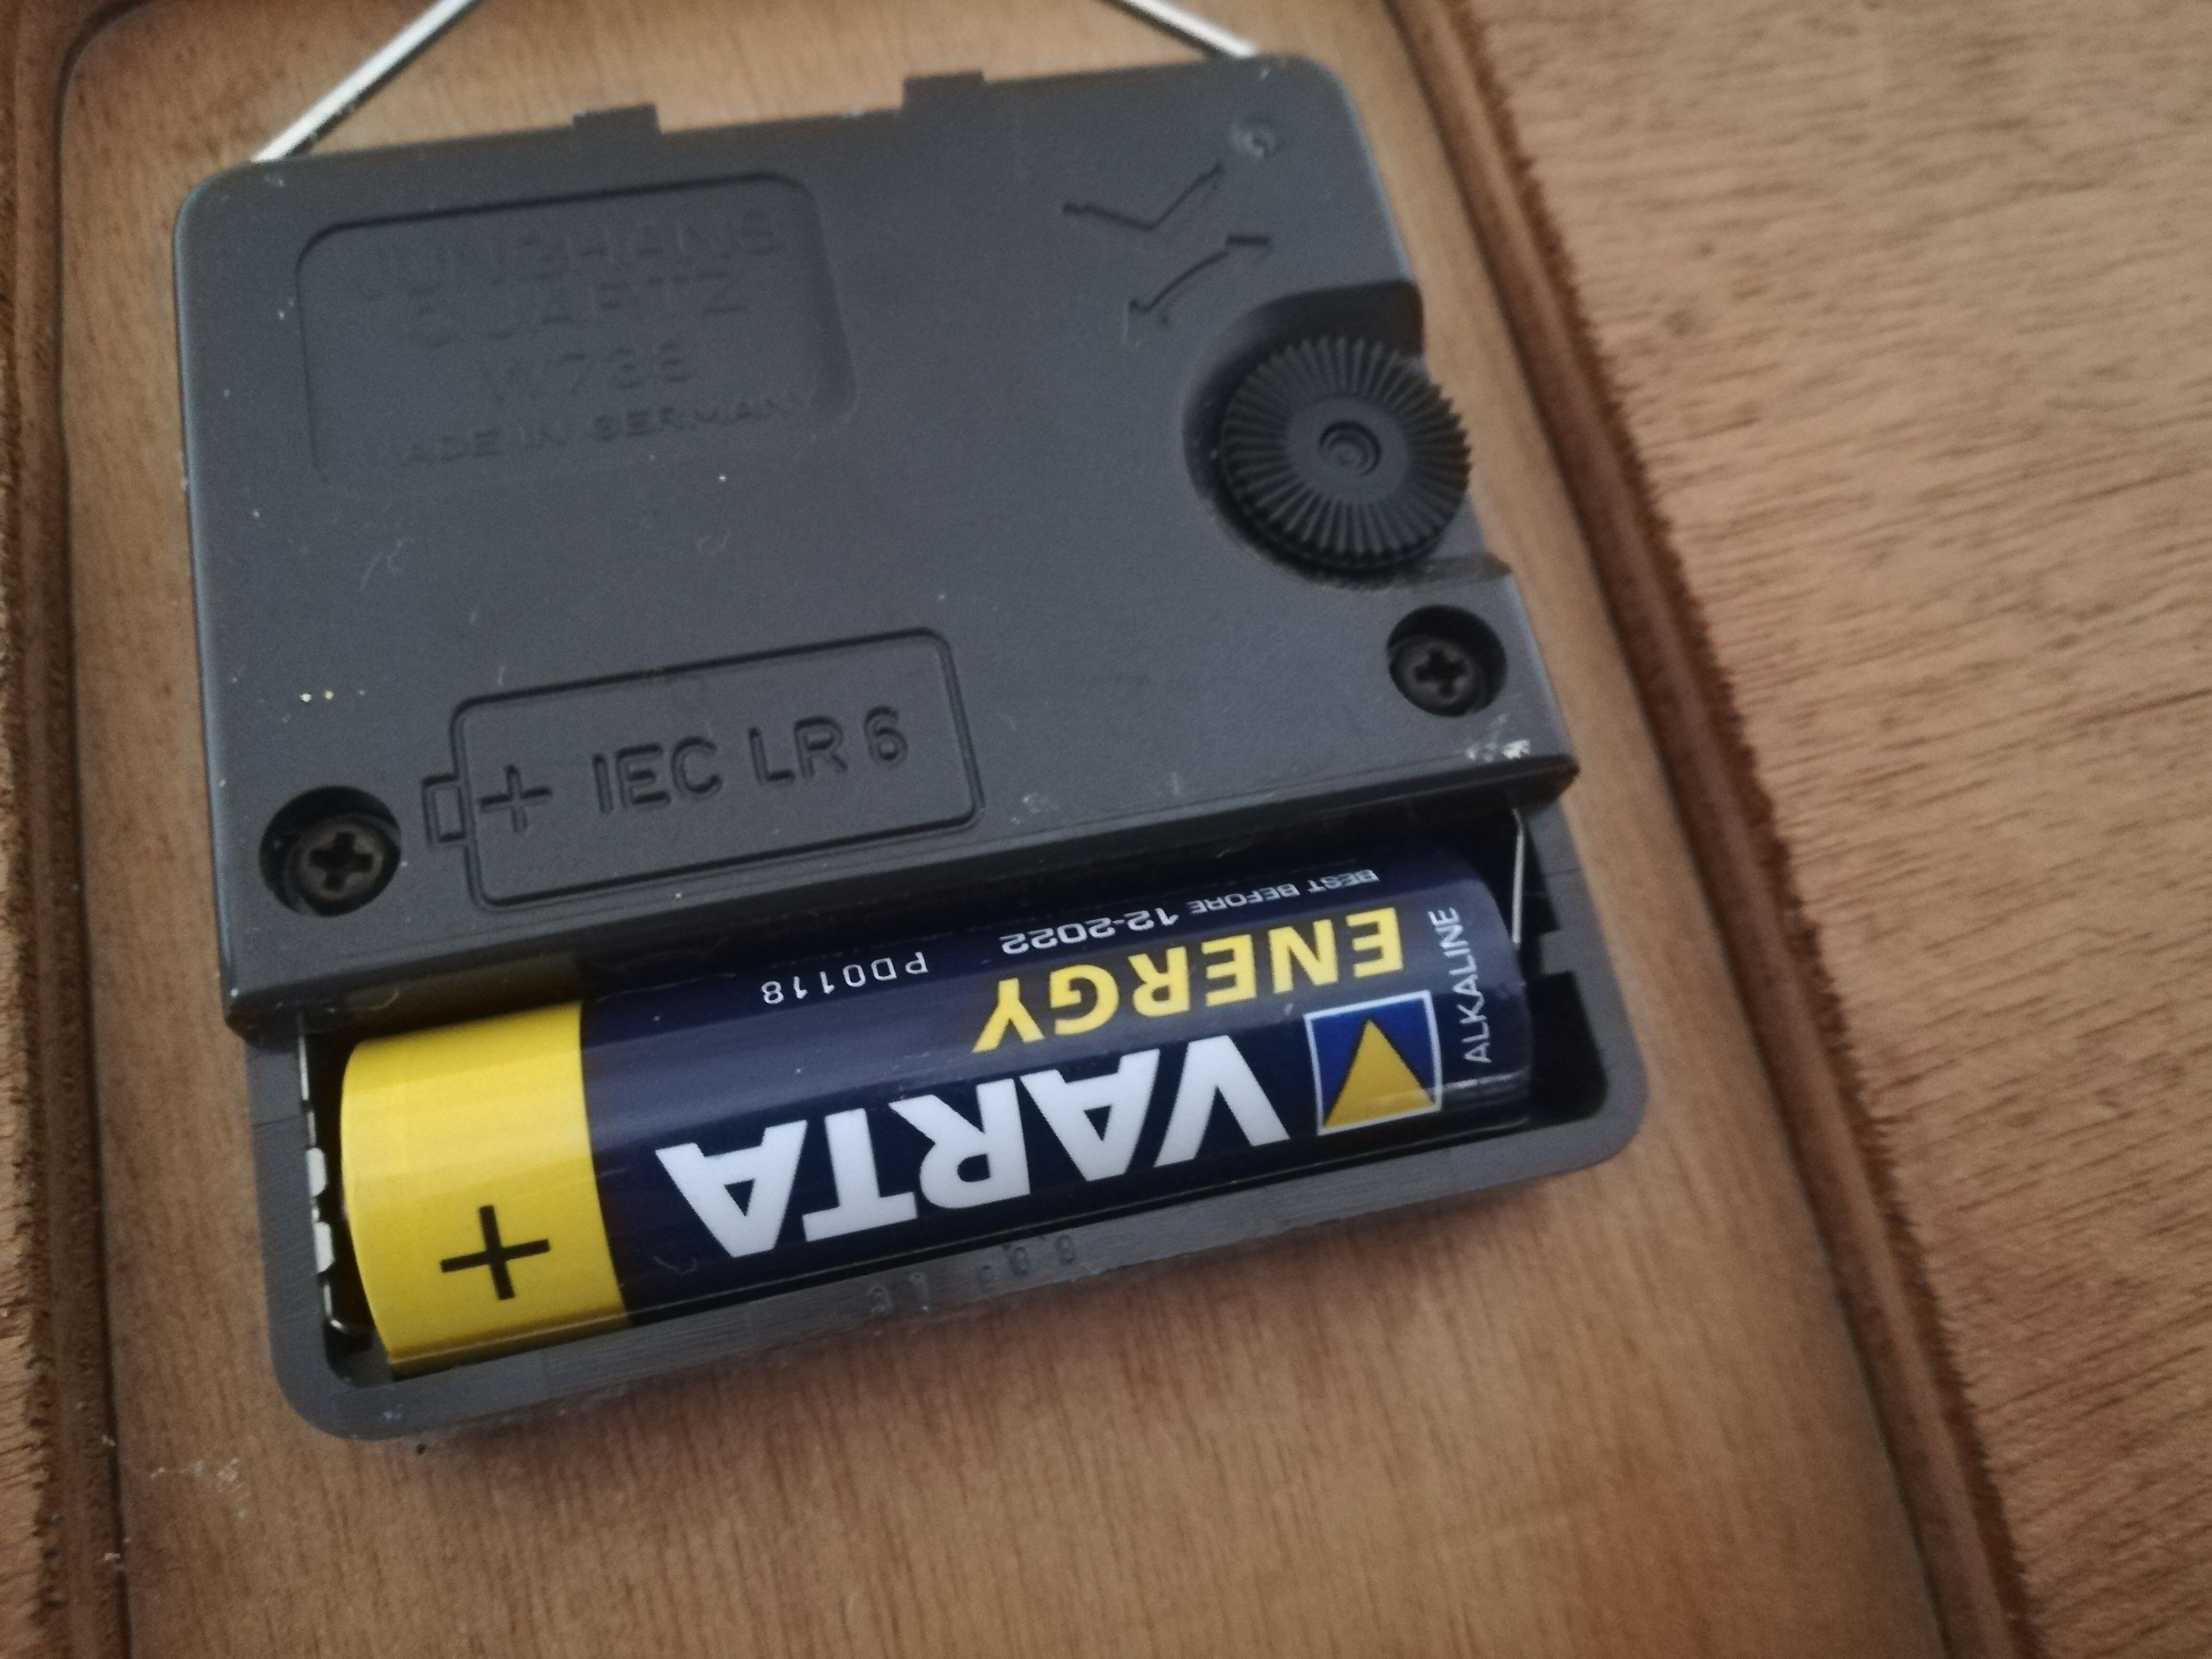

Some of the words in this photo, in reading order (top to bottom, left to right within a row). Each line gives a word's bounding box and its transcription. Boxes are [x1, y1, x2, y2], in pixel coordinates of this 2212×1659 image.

[367, 430, 505, 473] ADE
[592, 735, 723, 814] IEC
[1188, 883, 1300, 915] BEFORE
[1307, 869, 1380, 894] BEST
[1000, 908, 1178, 955] 12-2022
[972, 907, 1403, 1053] ENERGY
[1427, 907, 1491, 1063] ALKALINE
[655, 1035, 1290, 1258] VARTA
